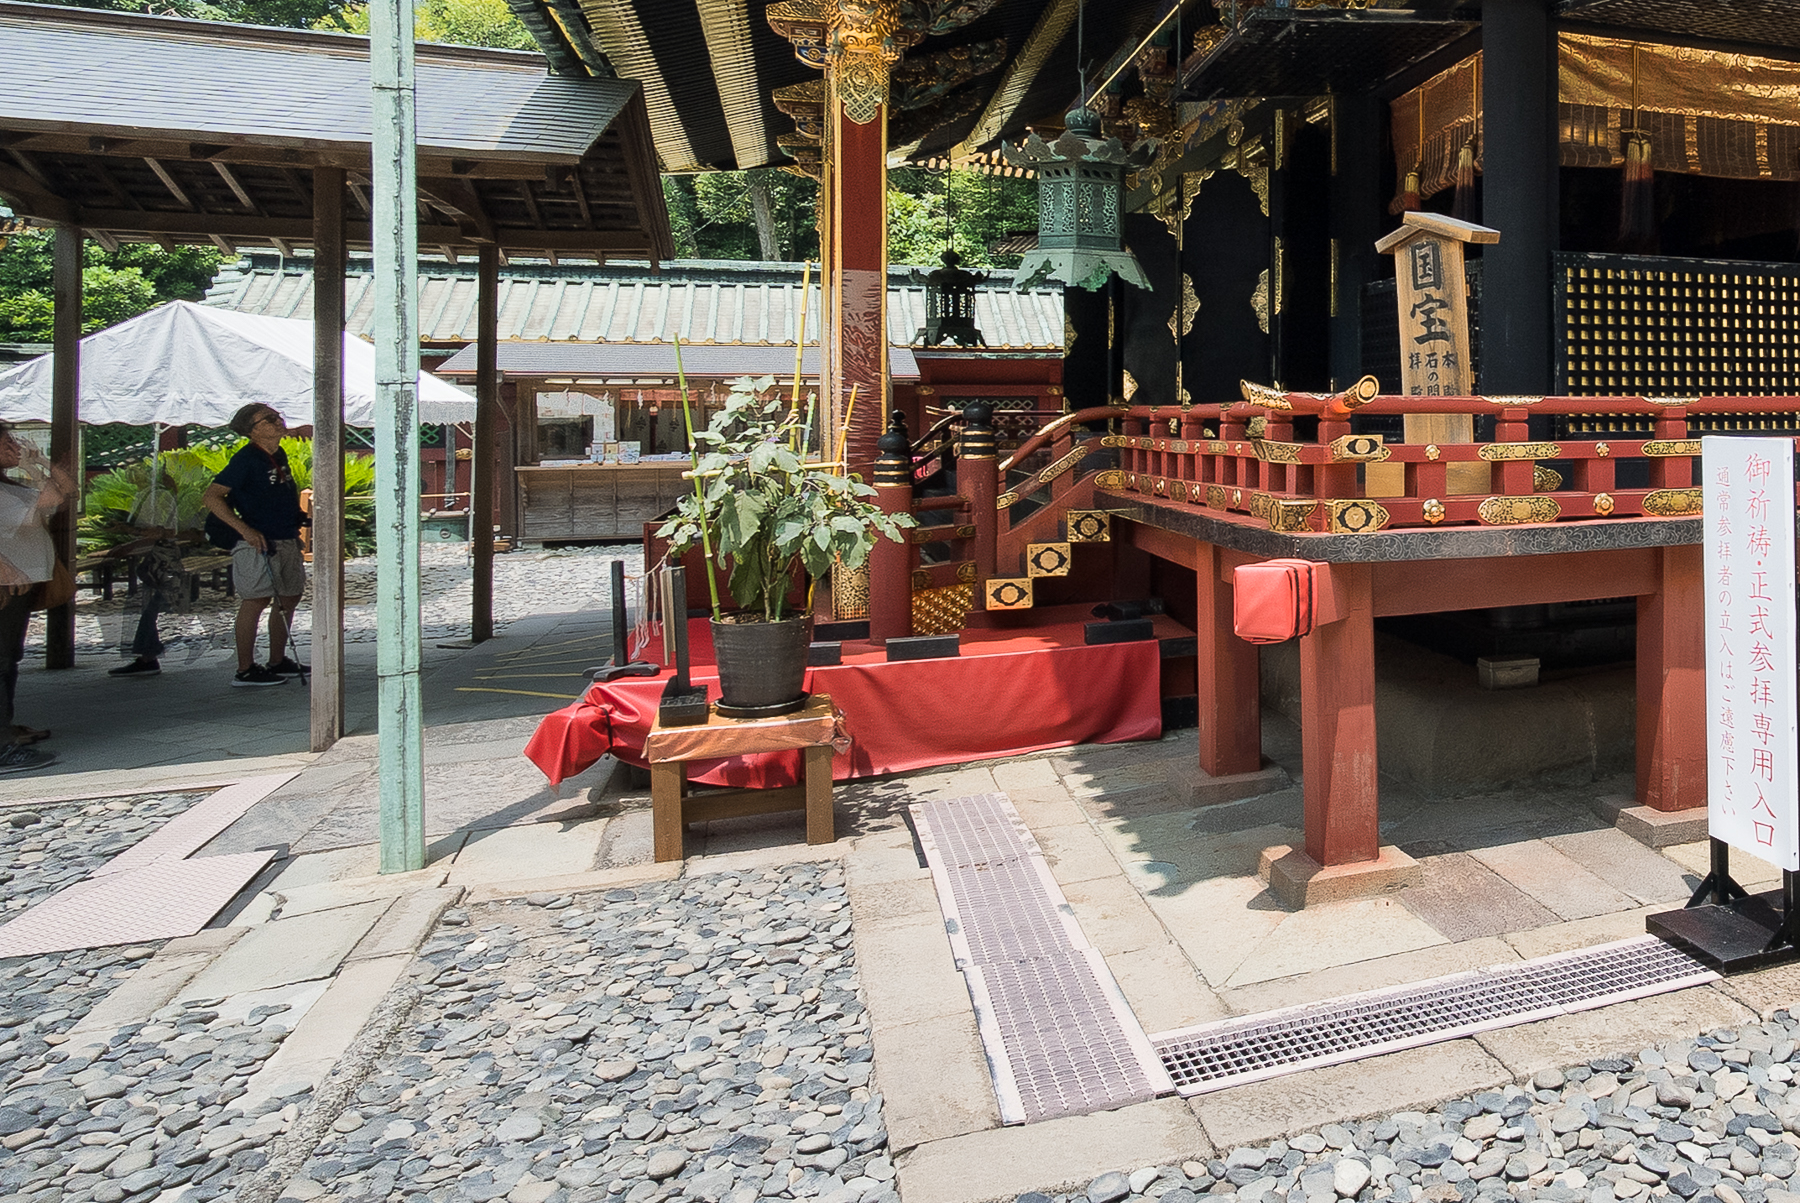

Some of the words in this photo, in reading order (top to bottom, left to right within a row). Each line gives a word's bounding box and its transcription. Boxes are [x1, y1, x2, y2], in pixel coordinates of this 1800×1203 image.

[1410, 241, 1450, 345] 国宝
[1715, 466, 1736, 816] 通常参拝者の立入はご遠慮下さい
